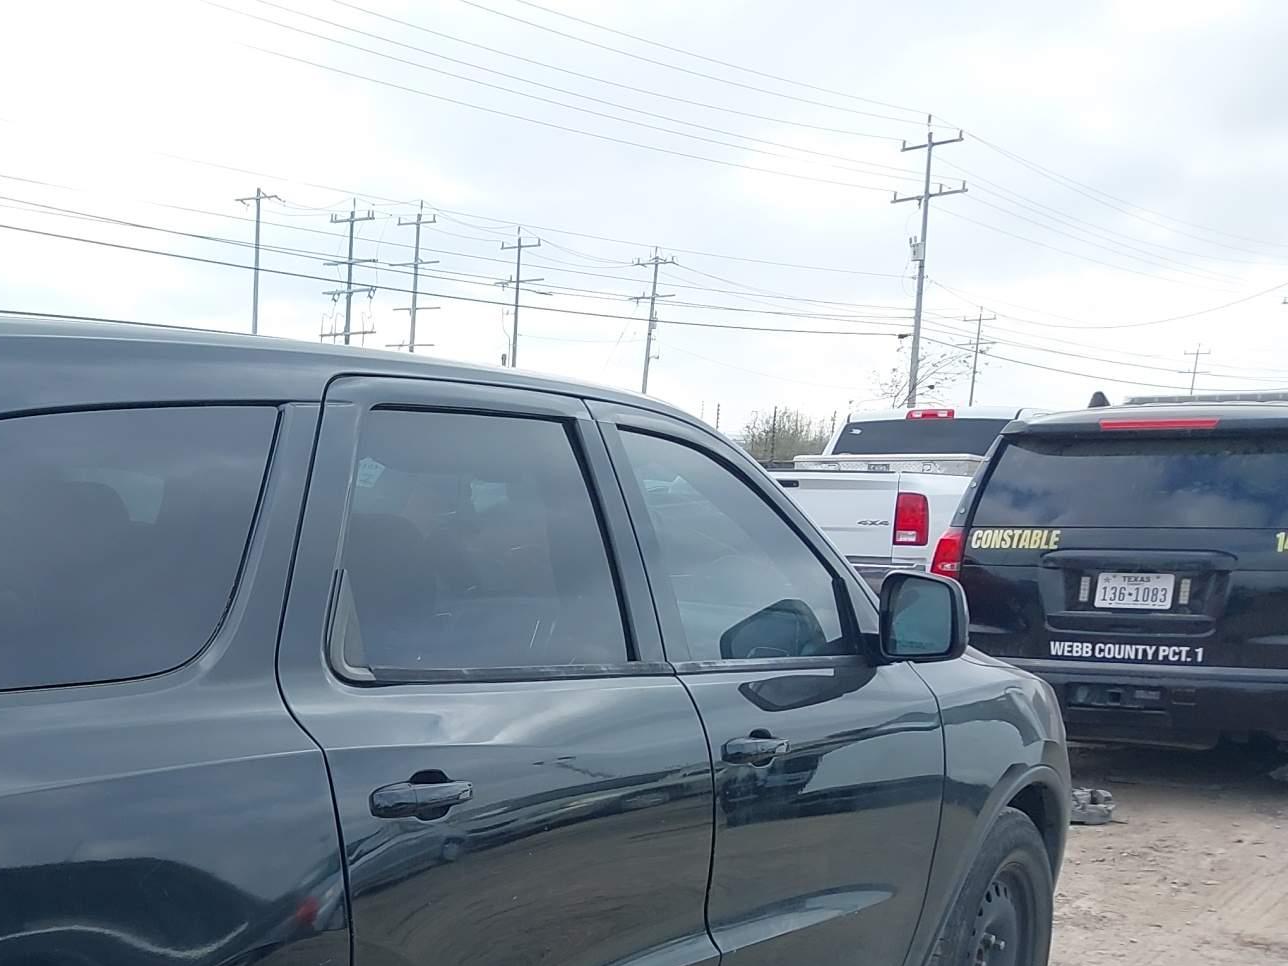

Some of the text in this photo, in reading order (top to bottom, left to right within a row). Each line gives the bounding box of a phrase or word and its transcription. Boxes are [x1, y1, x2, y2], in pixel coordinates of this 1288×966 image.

[971, 529, 1061, 549] CONSTABLE
[1122, 575, 1151, 583] TEXAS
[1049, 641, 1204, 662] WEBB COUNTY PCT. 1
